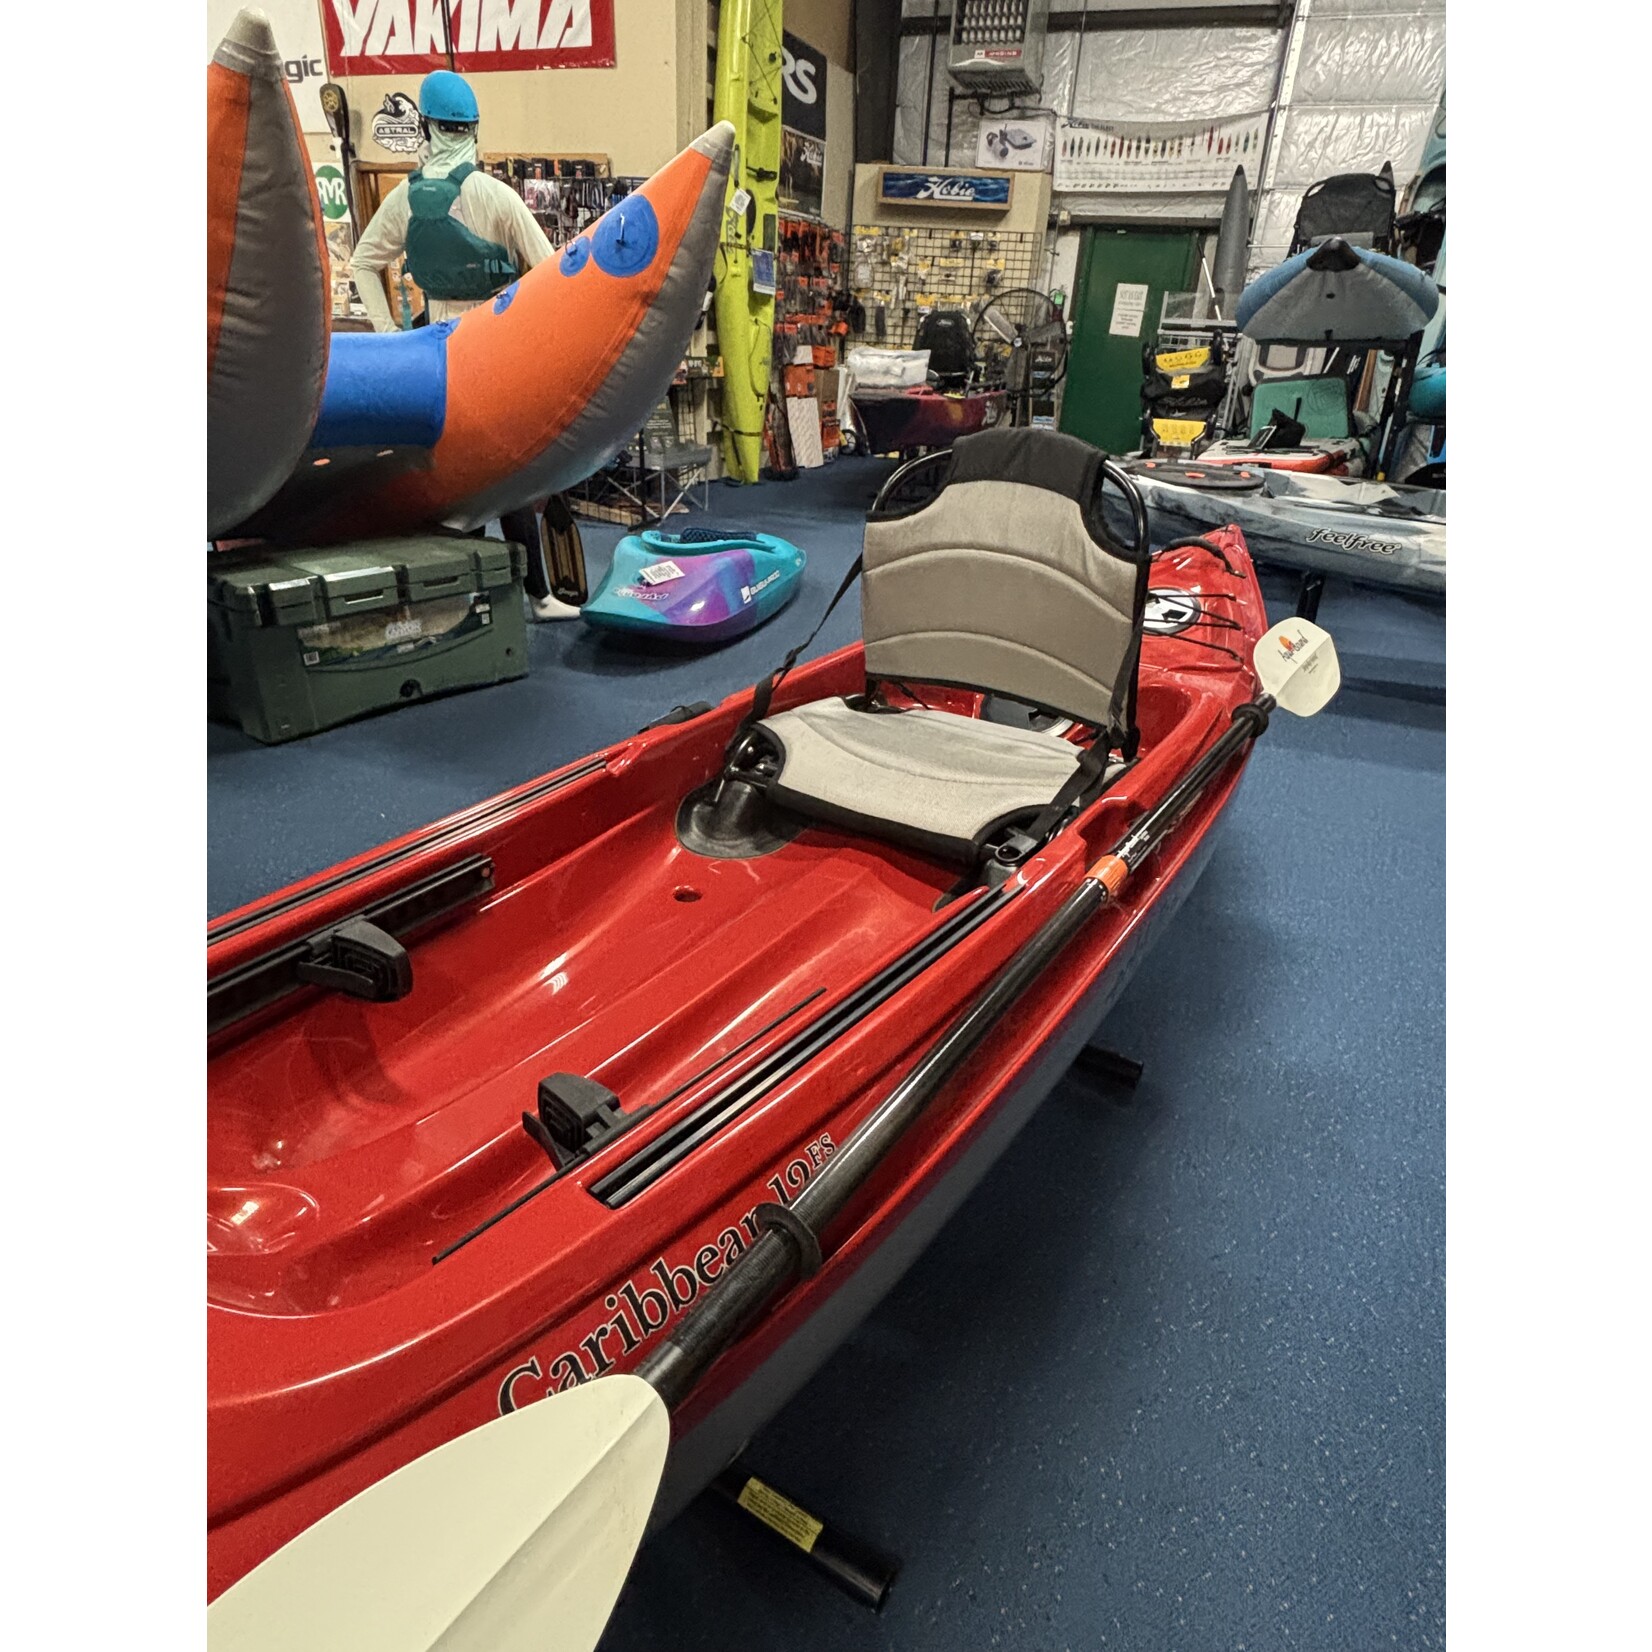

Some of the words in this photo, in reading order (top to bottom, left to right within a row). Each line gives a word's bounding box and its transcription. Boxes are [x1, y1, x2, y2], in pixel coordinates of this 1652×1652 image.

[333, 0, 592, 56] YAKIMA
[915, 175, 976, 201] Hobie
[1305, 527, 1398, 555] feelfree
